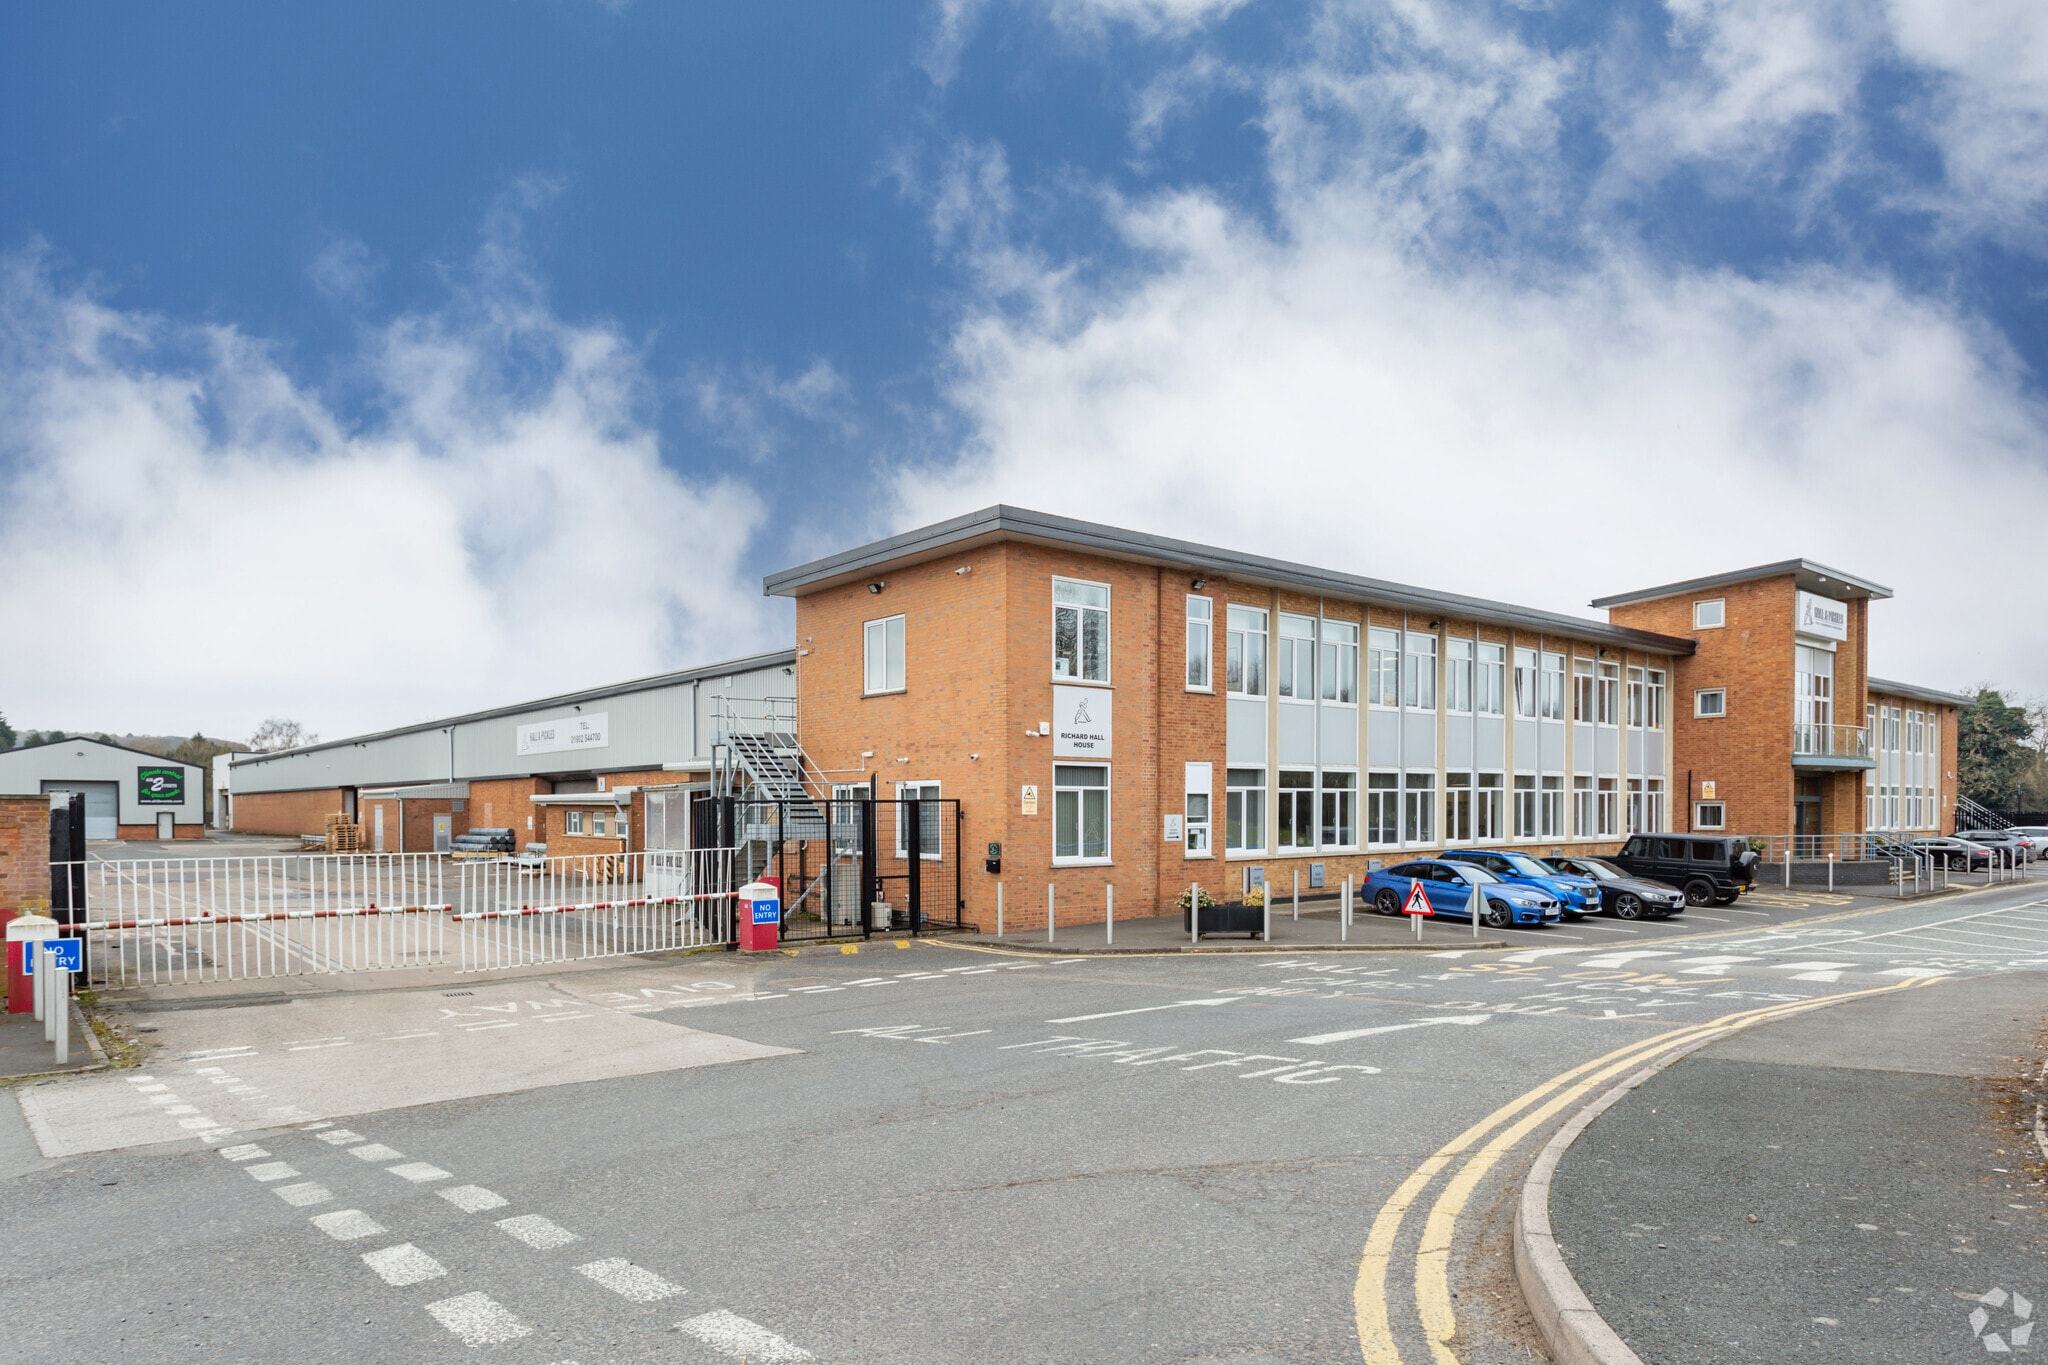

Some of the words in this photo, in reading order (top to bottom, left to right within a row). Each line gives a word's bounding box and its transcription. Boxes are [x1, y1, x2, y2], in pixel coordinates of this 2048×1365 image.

[1257, 960, 1399, 976] HALL
[1489, 976, 1812, 1001] PICKLES
[1281, 977, 1433, 990] CARS
[1448, 963, 1737, 985] SLOW
[588, 981, 736, 1002] GIVE
[1518, 992, 1700, 1007] HGV
[440, 998, 590, 1020] WAY
[1425, 1000, 1657, 1020] ONLY
[830, 1024, 992, 1044] ALL
[996, 1035, 1383, 1084] TRAFFIC
